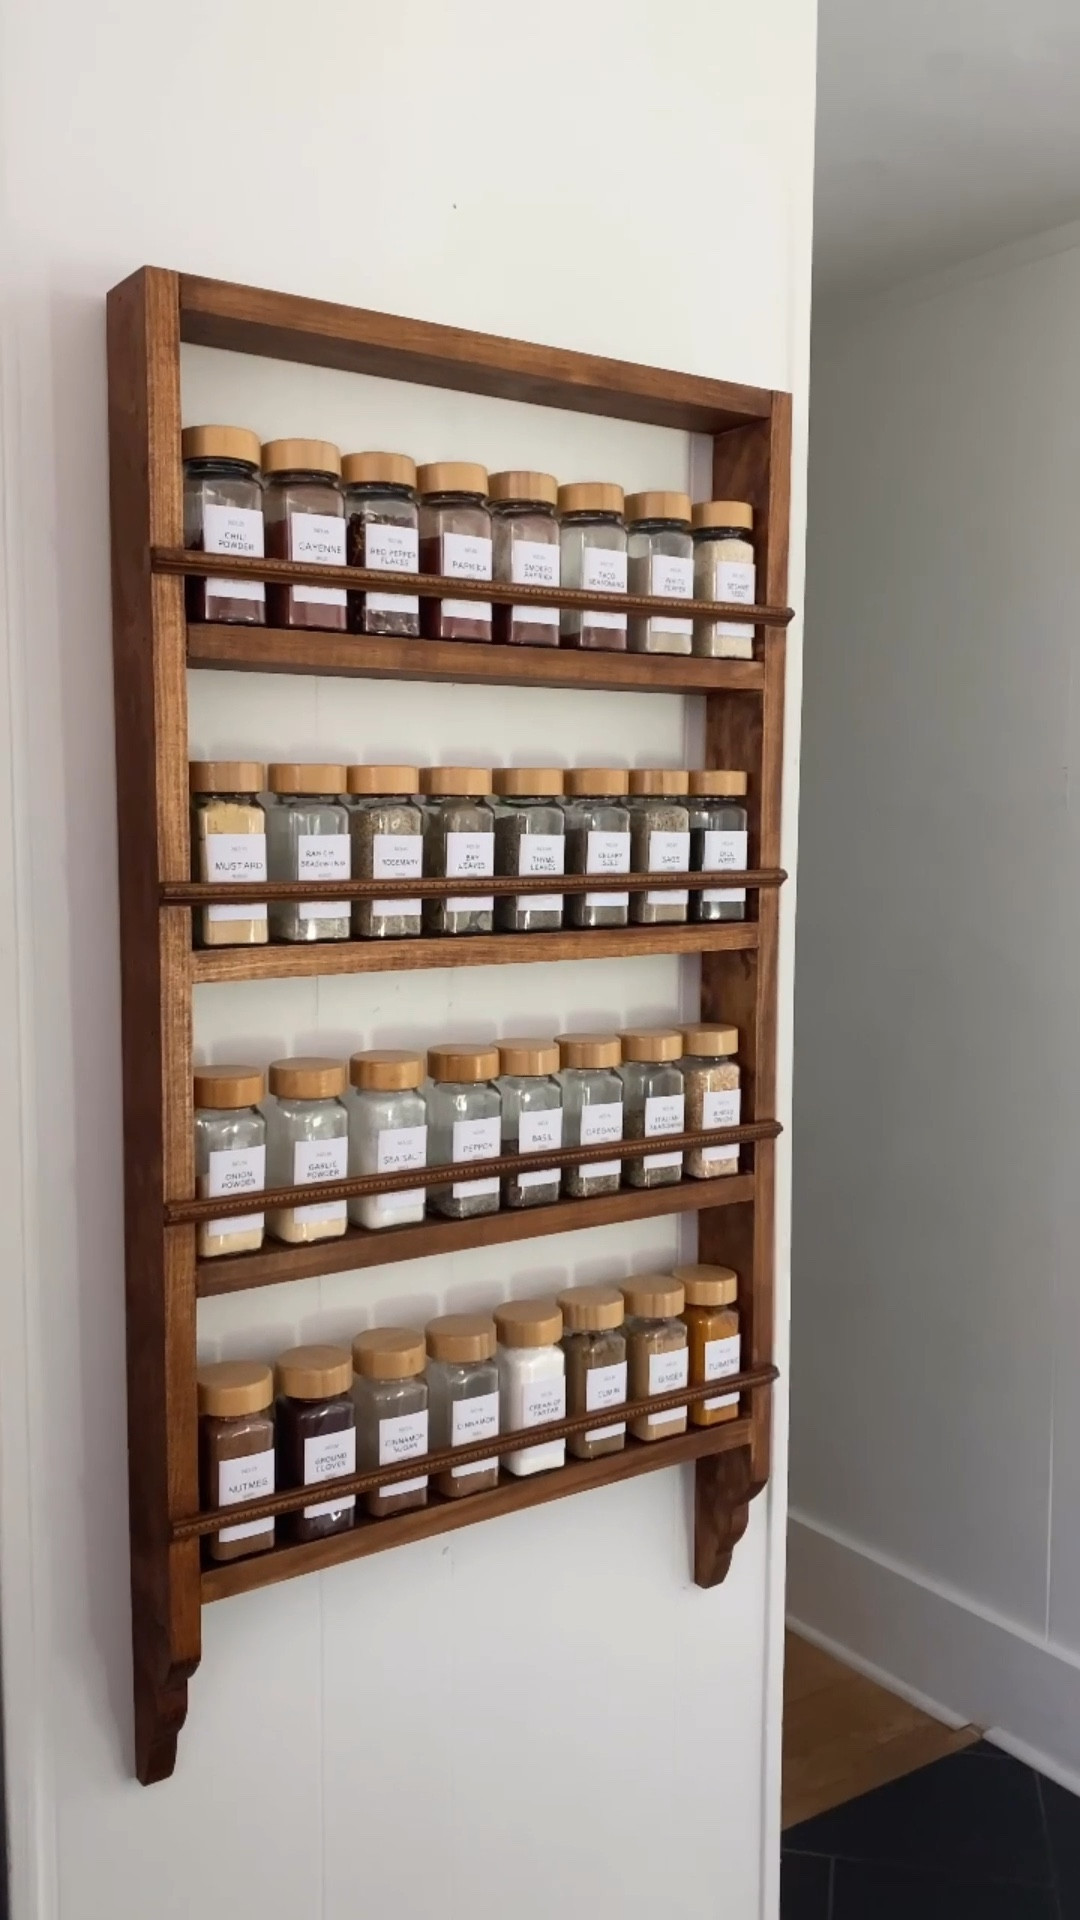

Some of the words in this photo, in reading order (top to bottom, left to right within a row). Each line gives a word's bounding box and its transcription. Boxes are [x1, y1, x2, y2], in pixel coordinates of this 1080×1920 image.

[224, 532, 247, 541] CHILI
[219, 540, 254, 549] POWDER
[299, 543, 341, 553] CAYENNE
[389, 550, 417, 559] PEPPER
[381, 557, 410, 566] FLAKES
[453, 561, 487, 572] PAPRIKA
[599, 571, 616, 579] TACO
[216, 862, 263, 870] MUSTARD
[586, 1127, 620, 1135] OREGANO
[532, 1134, 553, 1142] BASIL
[384, 1156, 400, 1164] SEA
[403, 1152, 424, 1162] SALT
[309, 1161, 338, 1170] GARLIC
[226, 1172, 254, 1181] ONION
[307, 1168, 340, 1178] POWDER
[222, 1179, 256, 1188] POWDER
[658, 1372, 683, 1383] GINGER
[457, 1417, 496, 1430] CINNAMON
[385, 1434, 424, 1447] CINNAMON
[315, 1453, 348, 1465] GROUND
[315, 1460, 346, 1472] CLOVES
[229, 1479, 268, 1493] NUTMEG
